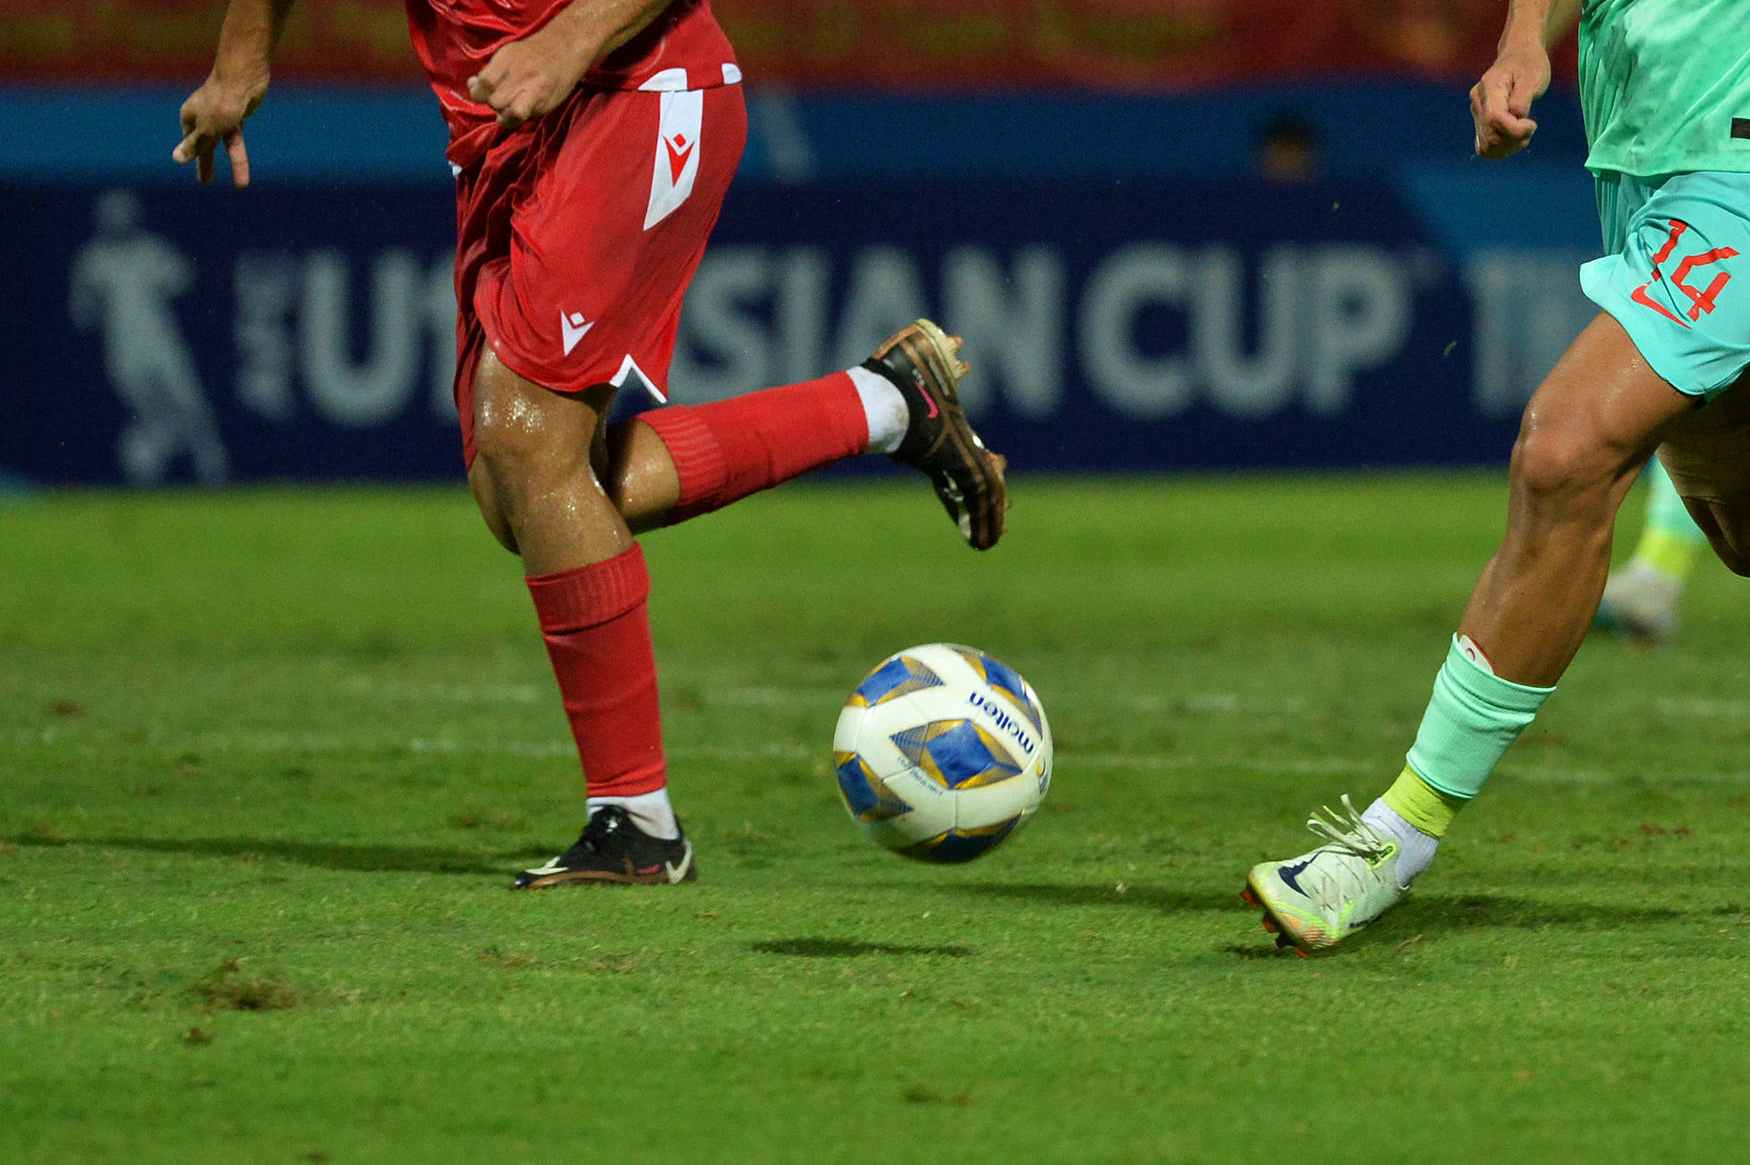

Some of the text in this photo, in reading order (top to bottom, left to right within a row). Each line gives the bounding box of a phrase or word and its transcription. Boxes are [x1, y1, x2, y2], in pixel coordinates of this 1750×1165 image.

[1650, 219, 1740, 321] 14
[670, 243, 1068, 423] SIAN
[1076, 240, 1415, 423] CUP
[969, 691, 1034, 754] molten
